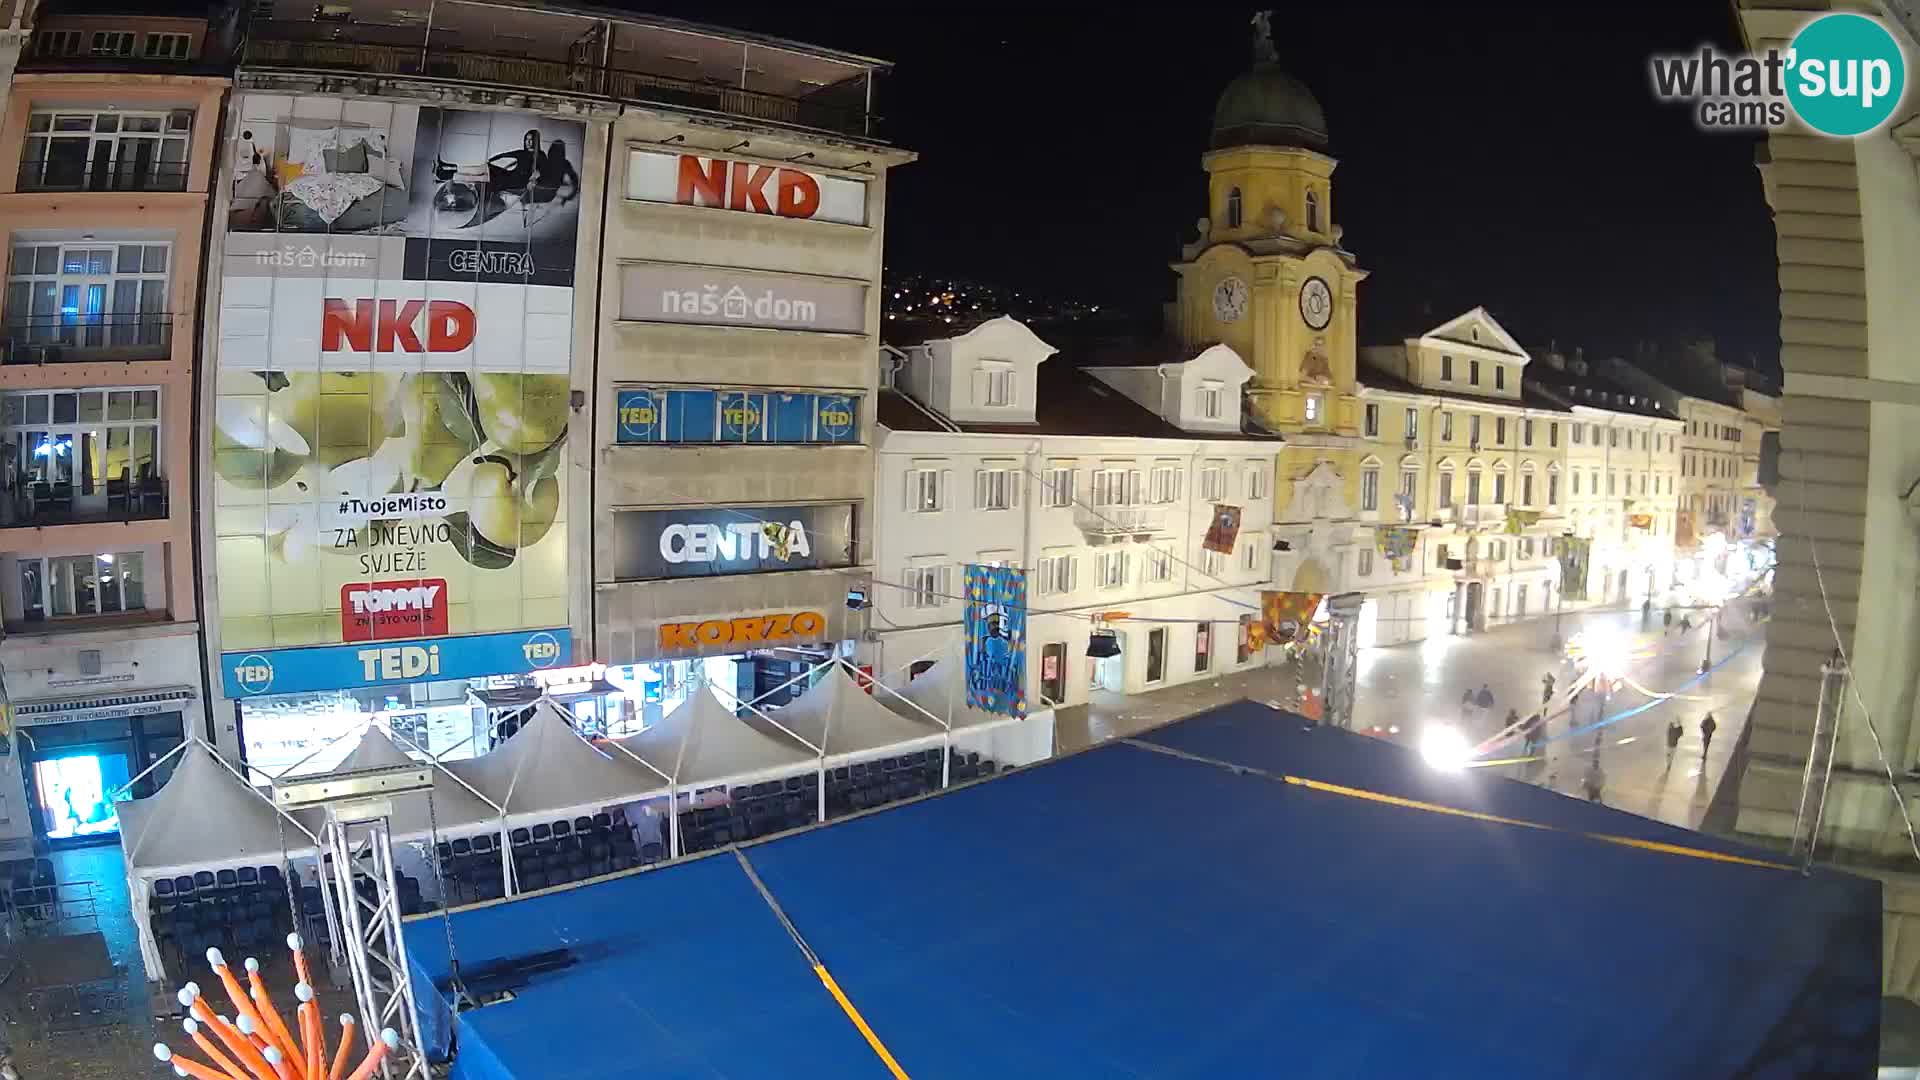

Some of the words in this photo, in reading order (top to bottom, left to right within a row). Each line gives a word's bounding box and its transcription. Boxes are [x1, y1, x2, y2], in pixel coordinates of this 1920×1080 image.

[676, 154, 821, 219] NKD
[255, 246, 294, 268] naš
[320, 248, 369, 268] dom
[449, 249, 536, 275] CENTRA
[661, 283, 720, 316] naš
[753, 290, 817, 322] dom
[321, 298, 478, 353] NKD
[339, 496, 447, 516] #TvojeMisto
[334, 527, 358, 548] ZA
[370, 522, 451, 547] DNEVNO
[359, 547, 427, 574] SVJEŽE
[349, 585, 440, 614] TOMMY
[659, 611, 827, 649] KORZO
[358, 644, 441, 682] TEDi
